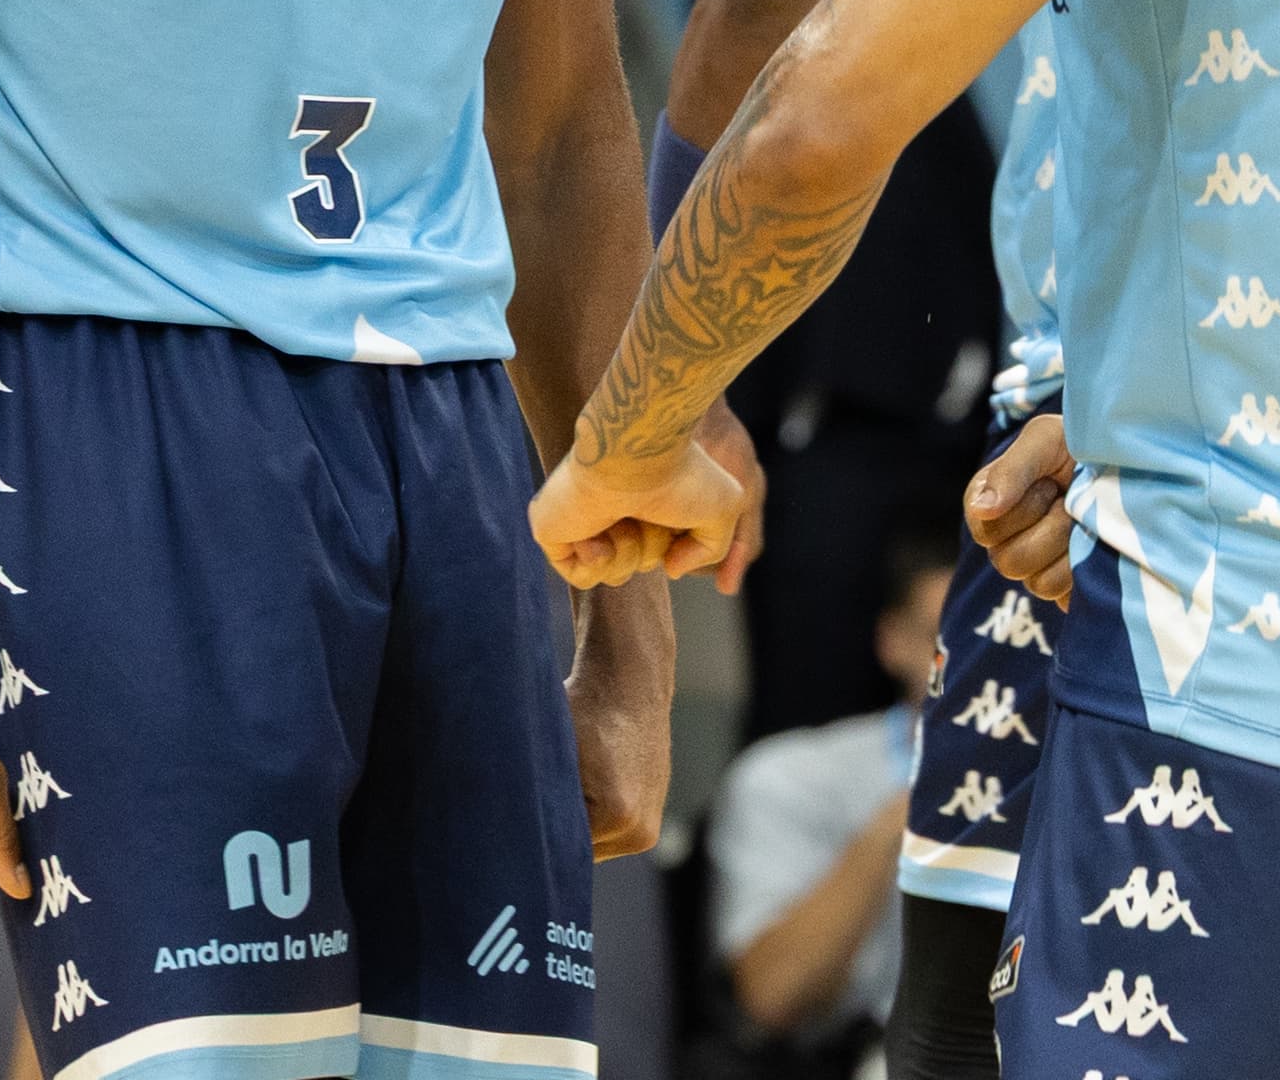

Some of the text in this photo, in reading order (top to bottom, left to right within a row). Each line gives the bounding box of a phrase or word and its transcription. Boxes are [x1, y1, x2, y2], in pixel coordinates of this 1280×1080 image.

[288, 94, 377, 245] 3
[154, 938, 279, 973] Andorra
[284, 934, 306, 961] la
